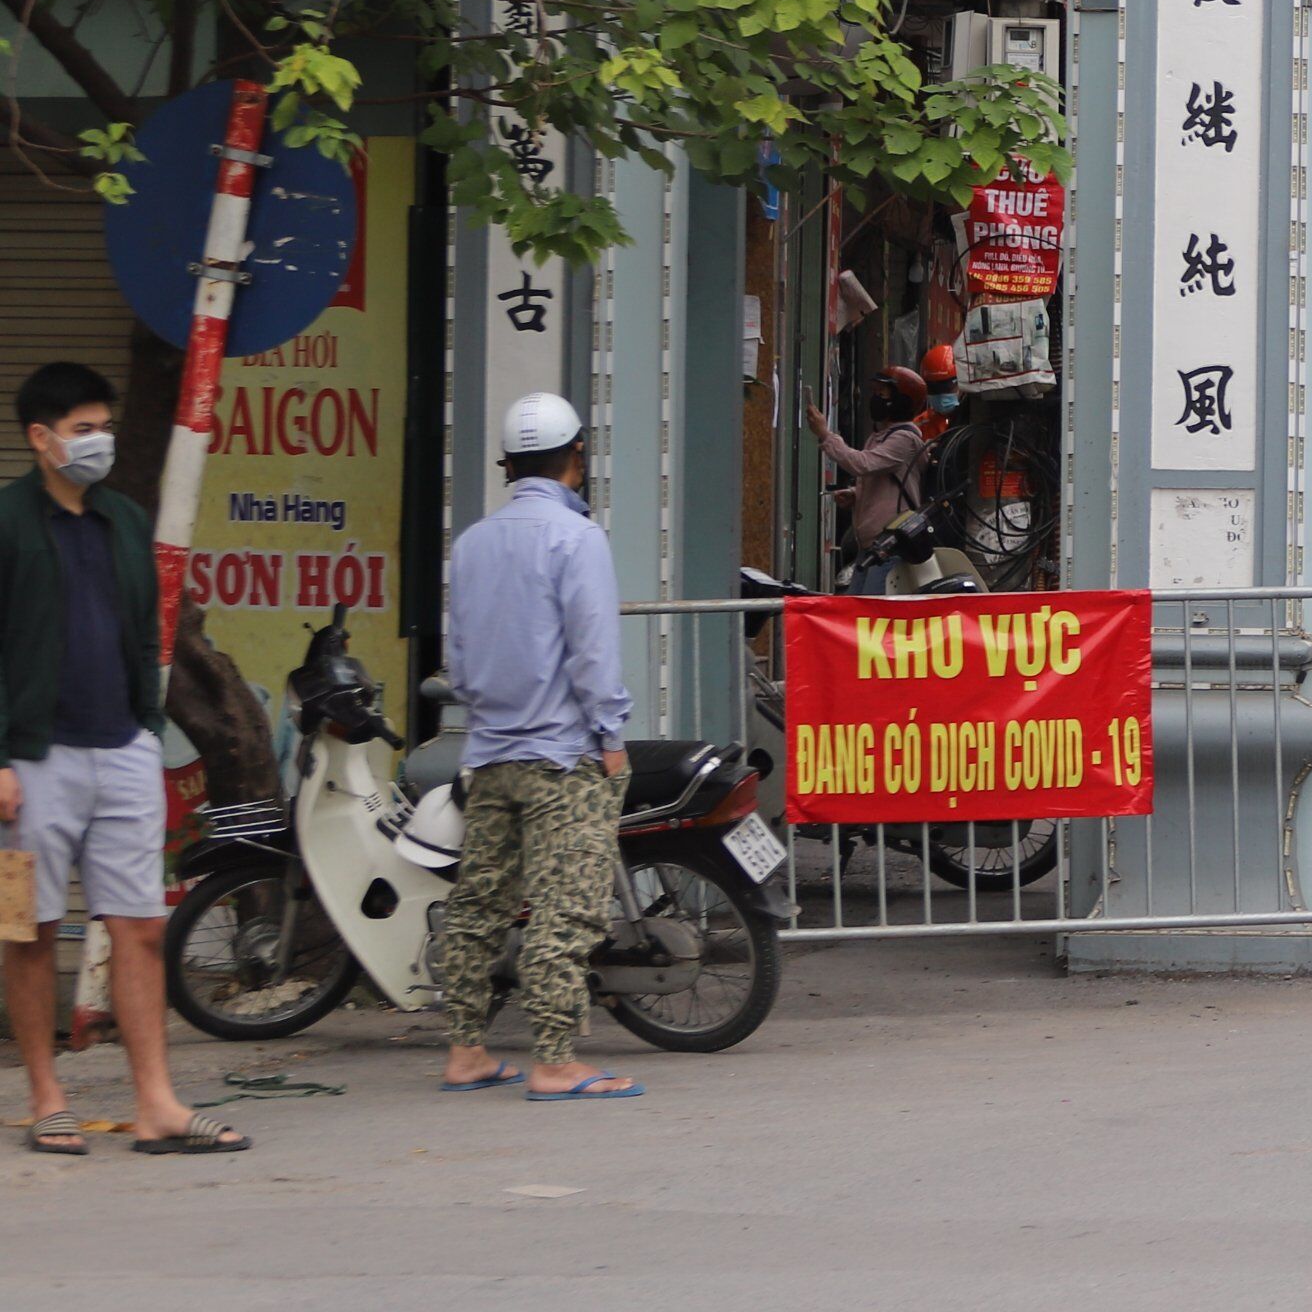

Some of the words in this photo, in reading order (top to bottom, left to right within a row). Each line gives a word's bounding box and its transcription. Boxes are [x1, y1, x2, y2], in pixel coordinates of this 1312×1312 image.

[984, 188, 1051, 218] THUÊ
[973, 219, 1058, 251] PHÒNG
[229, 492, 277, 522] Nhà
[282, 493, 346, 531] Hàng
[190, 550, 284, 608] SƠN
[296, 542, 386, 609] HÓI
[856, 614, 965, 680] KHU
[978, 605, 1083, 692] VỰC
[796, 723, 876, 795] ĐANG
[884, 707, 923, 795] CÓ
[930, 720, 997, 810] DỊCH
[1004, 718, 1085, 792] COVID
[1108, 716, 1143, 788] 19
